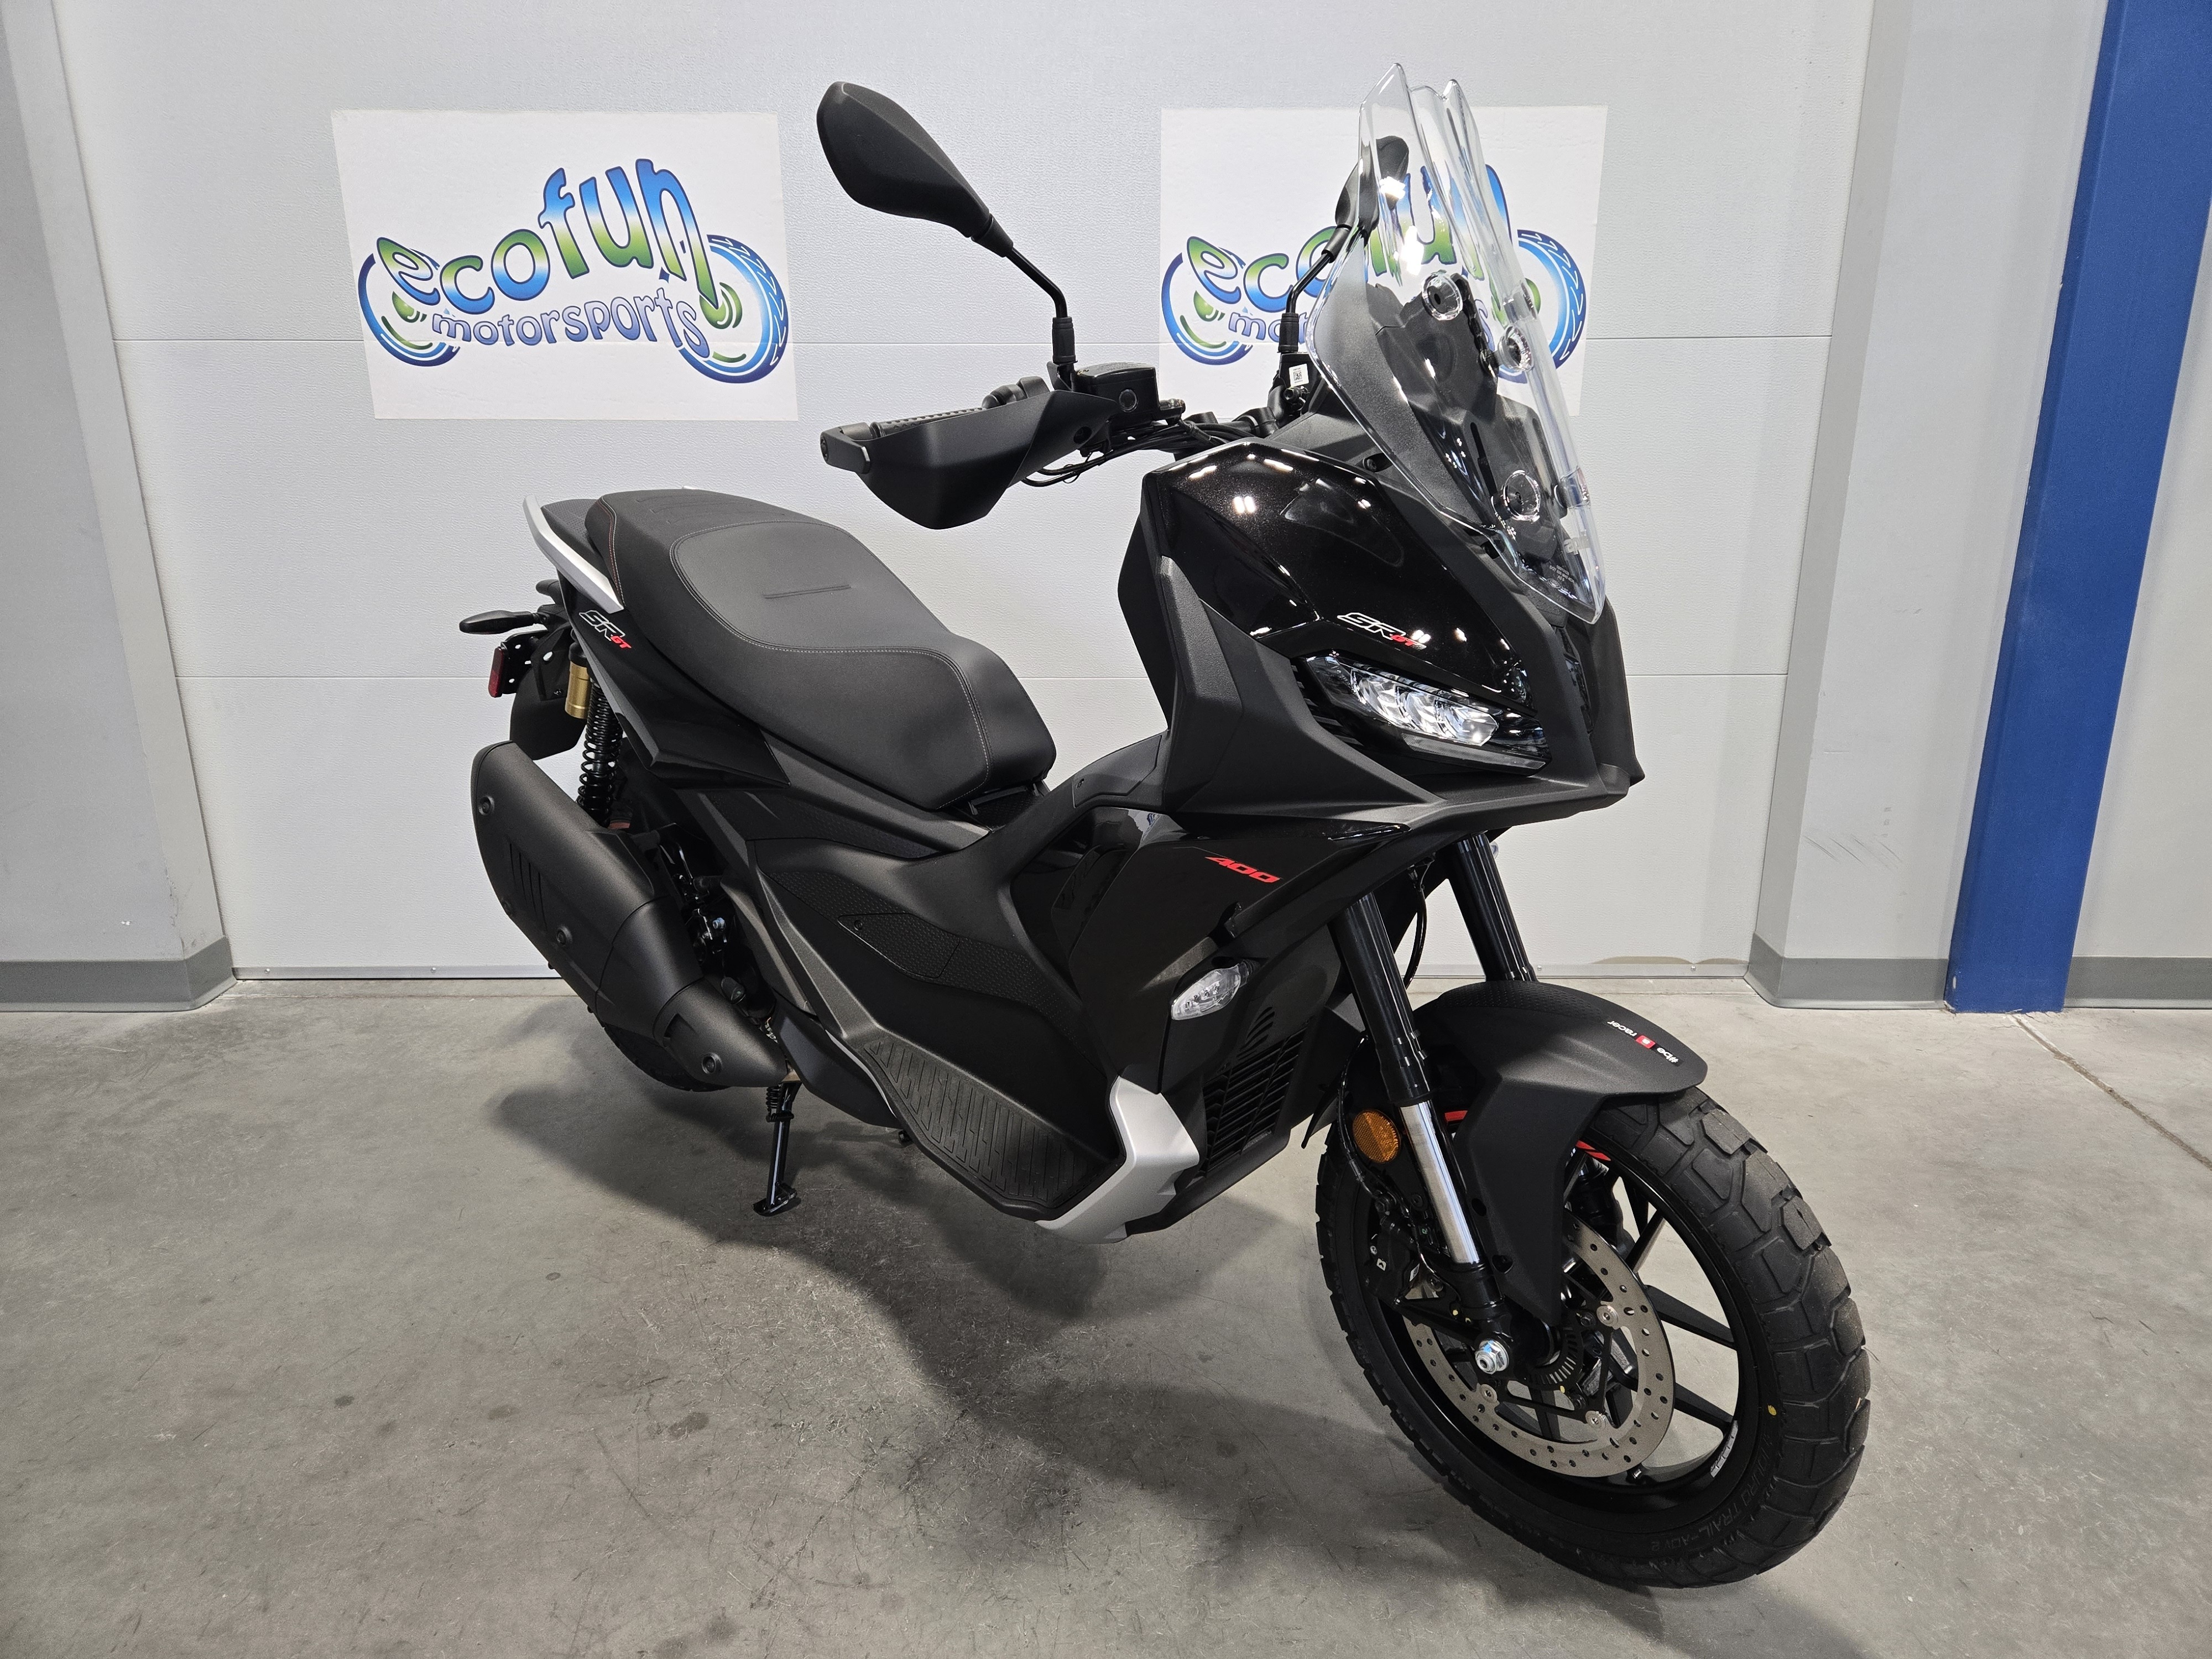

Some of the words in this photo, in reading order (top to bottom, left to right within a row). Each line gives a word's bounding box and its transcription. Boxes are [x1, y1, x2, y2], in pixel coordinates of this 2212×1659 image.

[377, 158, 719, 309] ecofun
[432, 287, 711, 358] motorsports
[579, 609, 625, 641] SR
[611, 635, 632, 649] GT
[1337, 612, 1406, 640] SR
[1204, 857, 1281, 883] 400
[1606, 1020, 1637, 1037] racer
[1657, 1047, 1679, 1063] #be
